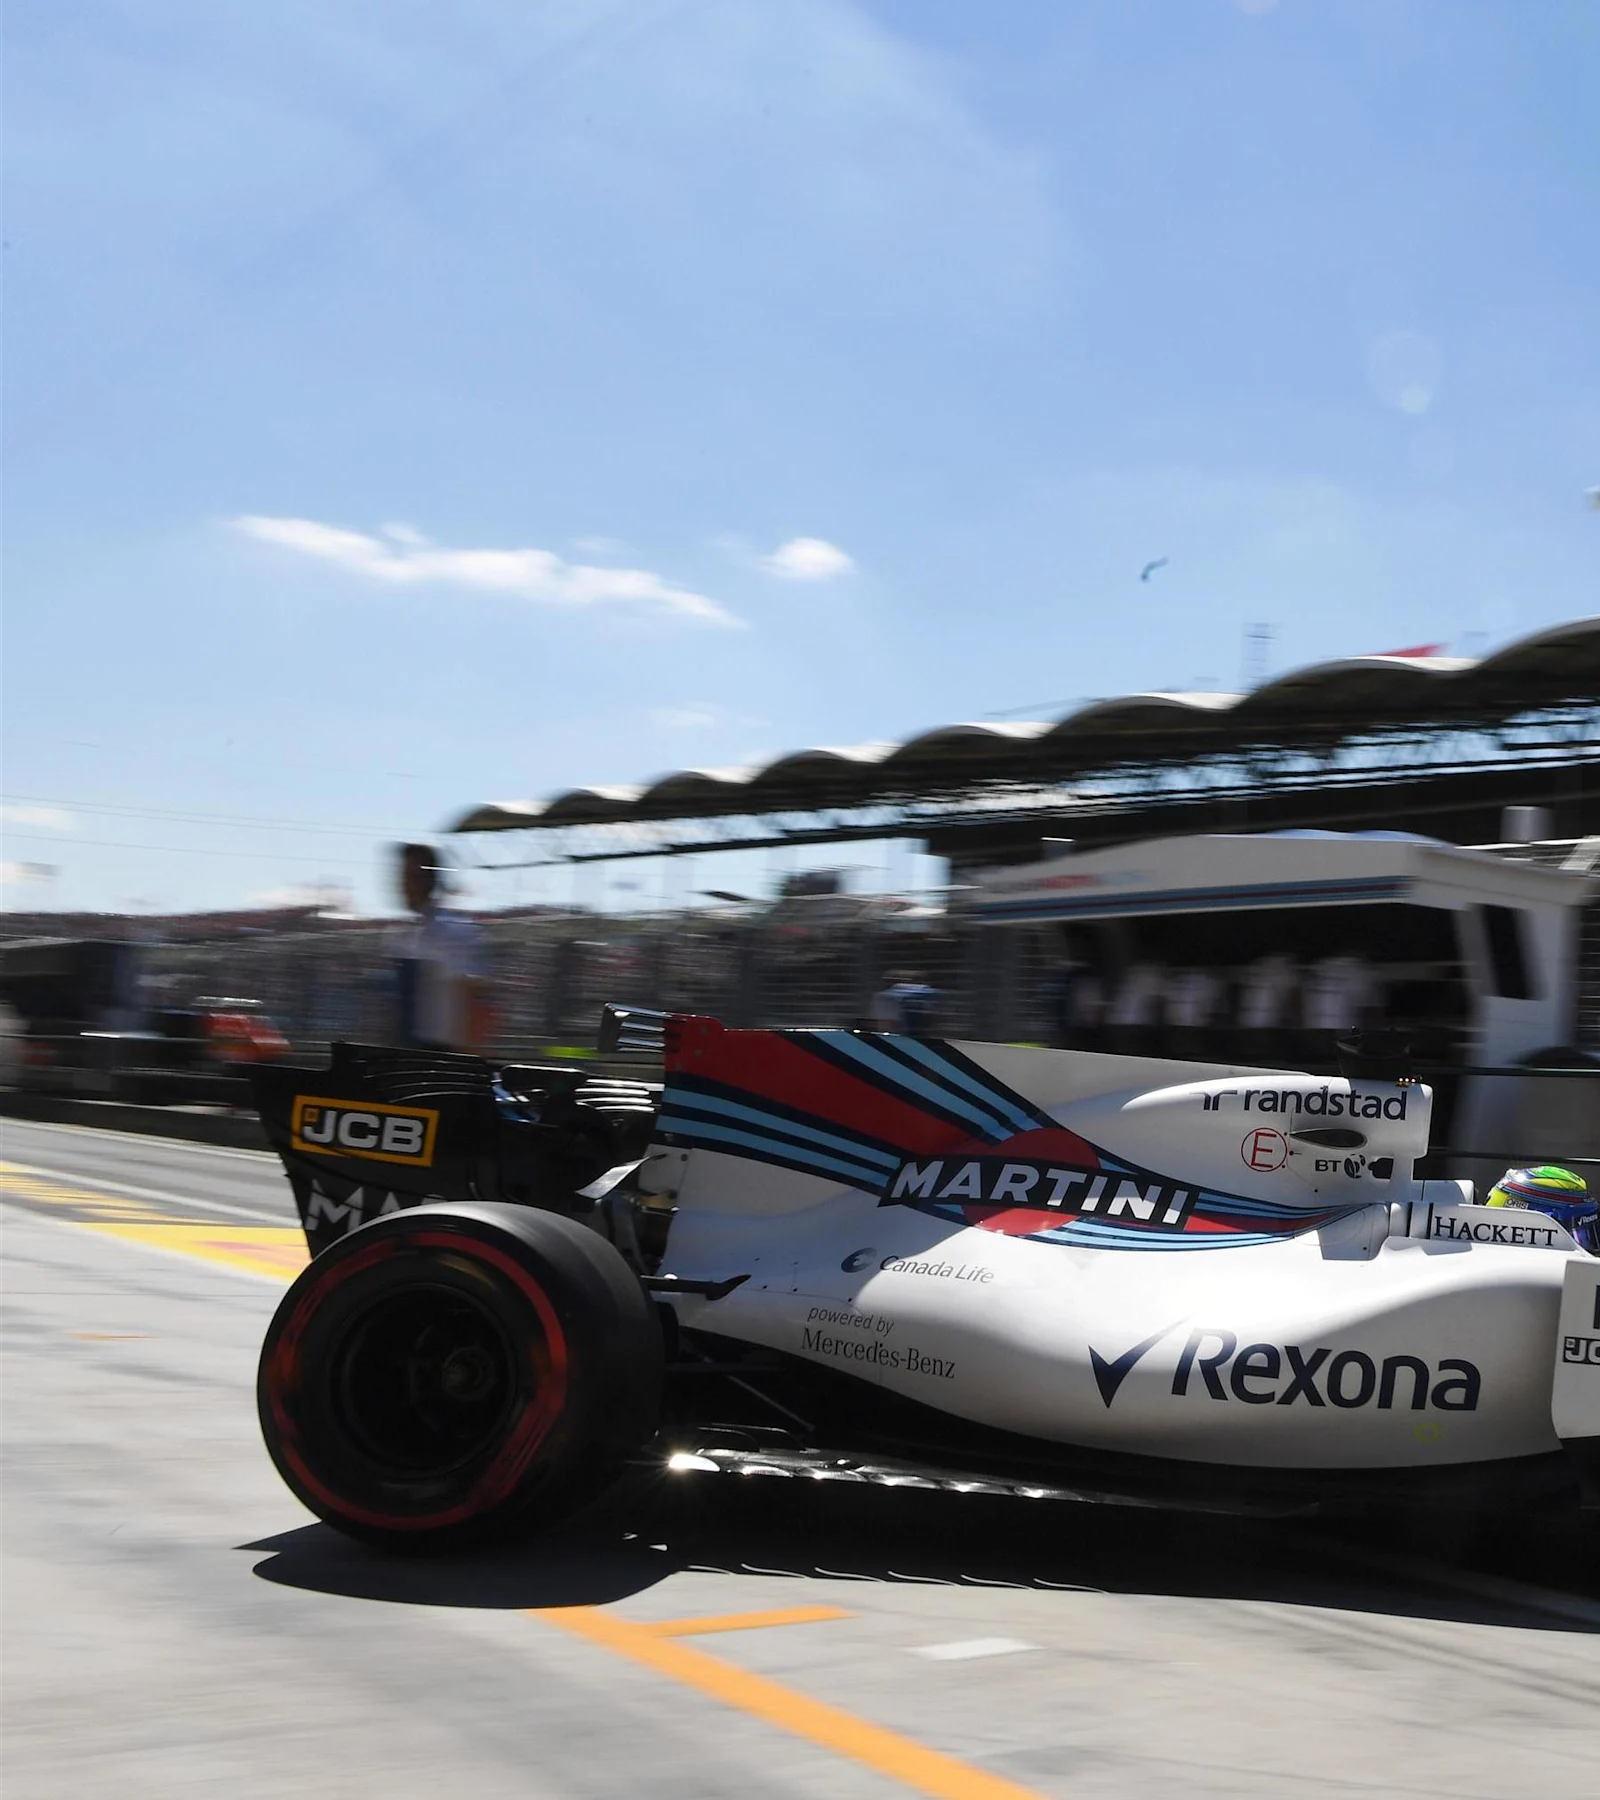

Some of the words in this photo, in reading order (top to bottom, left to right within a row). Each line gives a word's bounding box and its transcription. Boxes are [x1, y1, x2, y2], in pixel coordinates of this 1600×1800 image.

[1243, 1085, 1407, 1120] randstad
[303, 1110, 424, 1153] JCB
[1250, 1132, 1277, 1168] E
[1315, 1159, 1342, 1172] BT
[890, 1160, 1189, 1225] MARTINI
[1434, 1216, 1558, 1247] HACKETT
[880, 1255, 953, 1277] Canada
[955, 1264, 995, 1283] Life
[807, 1307, 874, 1329] powered
[876, 1318, 895, 1337] by
[801, 1327, 956, 1379] Mercedes-Benz
[1171, 1328, 1482, 1411] Rexona
